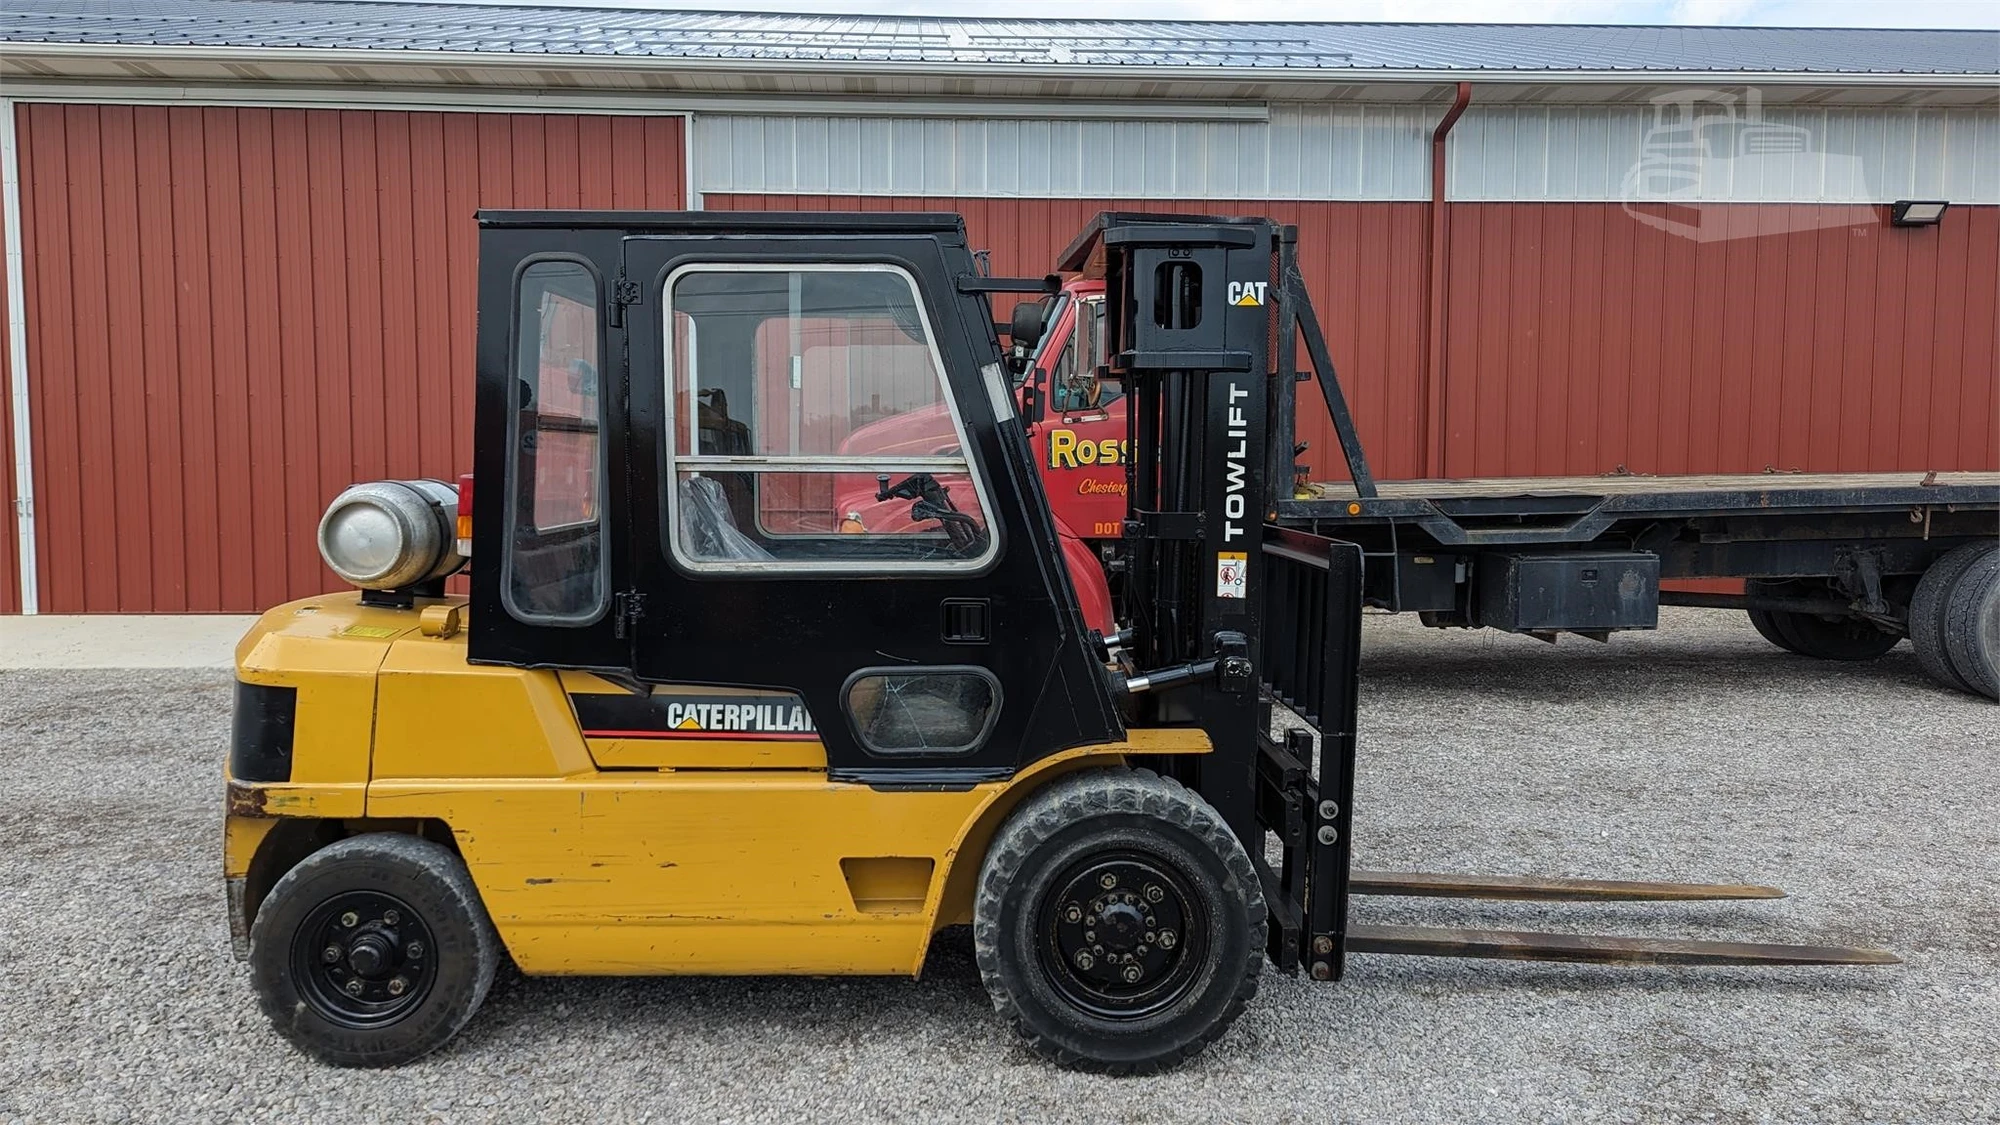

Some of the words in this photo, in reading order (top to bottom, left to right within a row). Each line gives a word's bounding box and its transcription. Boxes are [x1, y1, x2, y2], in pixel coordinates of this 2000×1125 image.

[1228, 281, 1268, 306] CAT
[1225, 383, 1248, 542] TOWLIFT
[1094, 522, 1120, 535] DOT
